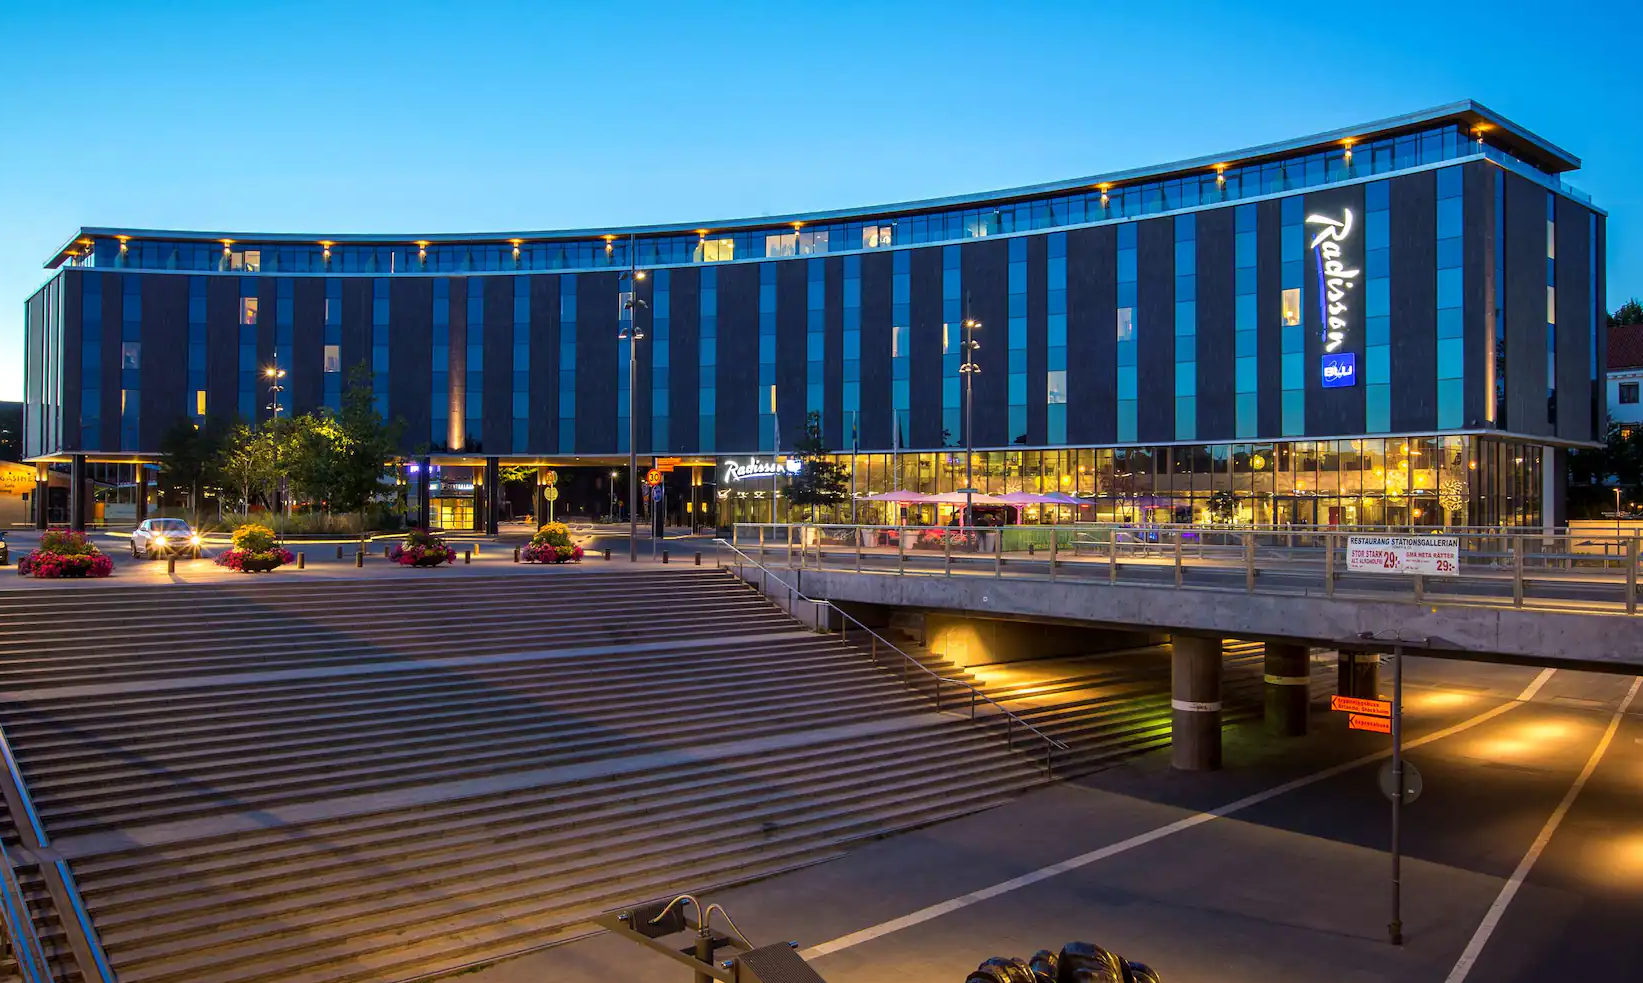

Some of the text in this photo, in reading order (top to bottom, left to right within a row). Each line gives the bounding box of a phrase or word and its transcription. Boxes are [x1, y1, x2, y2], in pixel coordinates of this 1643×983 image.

[1305, 207, 1360, 352] Radisson
[1324, 363, 1352, 379] BLU
[724, 456, 785, 483] Radisson
[1391, 538, 1458, 546] STATIONSGALLERIAN
[1436, 560, 1455, 571] 29:-
